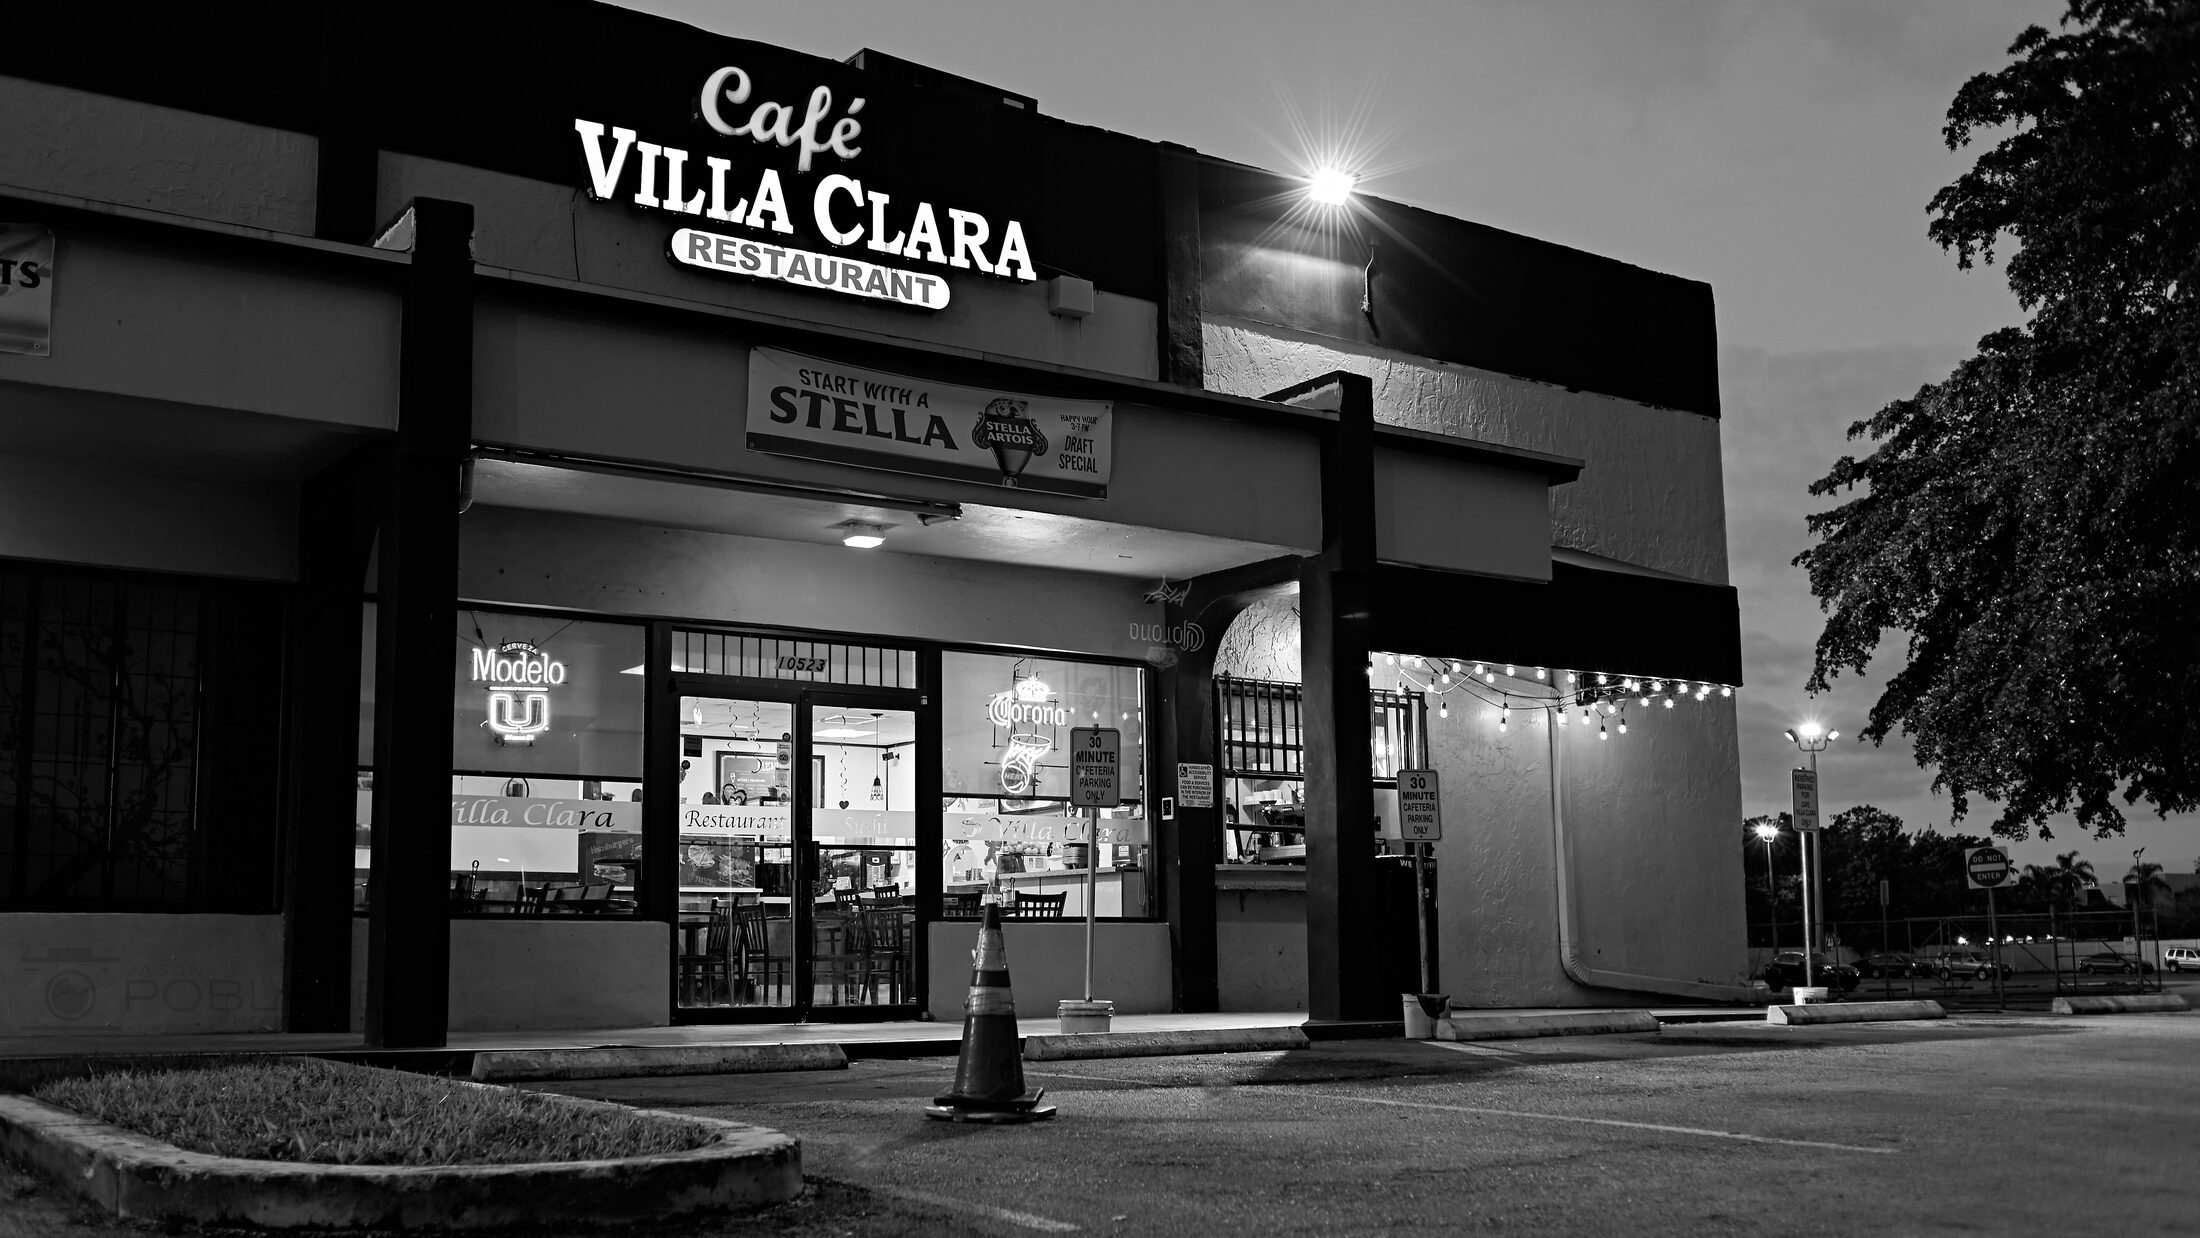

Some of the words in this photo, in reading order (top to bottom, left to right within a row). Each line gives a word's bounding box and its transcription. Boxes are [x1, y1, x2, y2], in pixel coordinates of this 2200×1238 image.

[700, 66, 866, 172] Café
[575, 119, 794, 234] VILLA
[813, 174, 1037, 281] CLARA
[688, 233, 936, 304] RESTAURANT
[799, 368, 859, 396] START
[864, 381, 912, 406] WITH
[916, 392, 929, 409] A
[769, 385, 960, 450] STELLA
[1060, 414, 1080, 423] HAPPY
[986, 421, 1032, 435] STELLA
[987, 431, 1034, 445] ARTOIS
[1064, 435, 1094, 455] DRAFT
[1059, 453, 1098, 474] SPECIAL
[501, 642, 539, 655] CERVEZA
[472, 648, 565, 684] Modelo
[778, 656, 825, 672] 10523
[988, 695, 1067, 728] Corona
[1089, 736, 1102, 748] 30
[1076, 750, 1115, 763] MINUTE
[1080, 778, 1112, 788] PARKING
[1410, 777, 1426, 789] 30
[1085, 790, 1105, 800] ONLY
[1402, 791, 1436, 800] MINUTE
[452, 800, 512, 825] illa
[523, 801, 615, 828] Clara
[1403, 803, 1436, 812] CAFETERIA
[685, 810, 787, 830] Restaurant
[1408, 814, 1433, 823] PARKING
[989, 817, 1054, 842] Villa
[1413, 825, 1429, 834] ONLY
[1400, 860, 1413, 868] WE
[1977, 872, 2001, 880] ENTER
